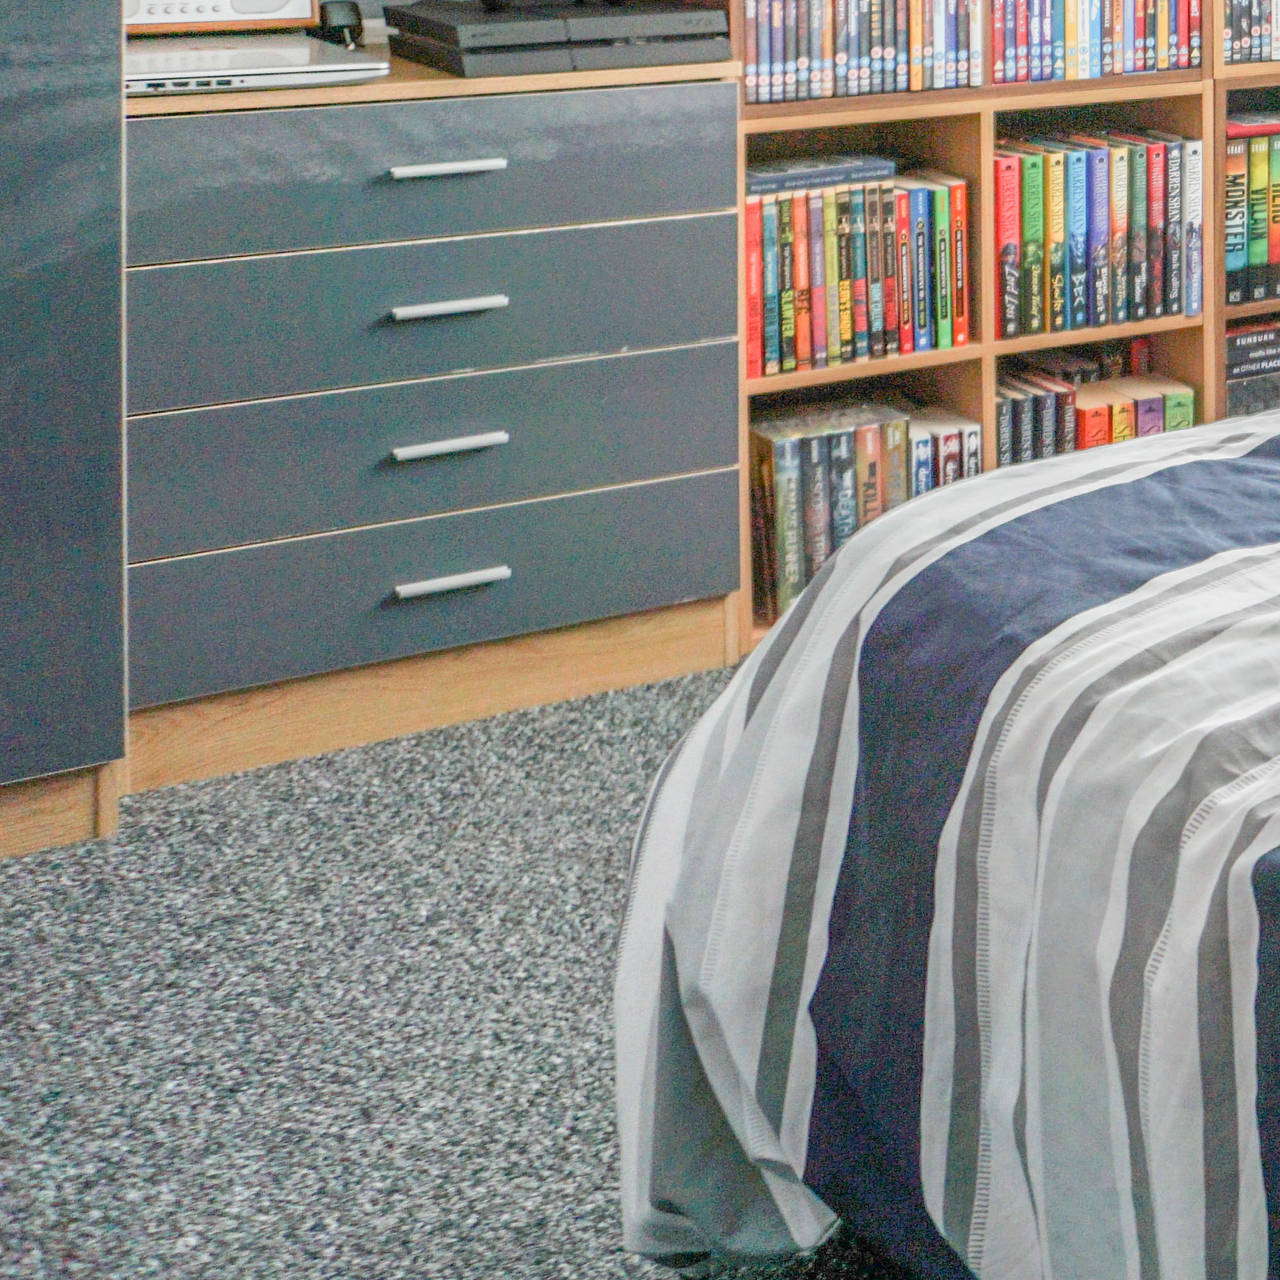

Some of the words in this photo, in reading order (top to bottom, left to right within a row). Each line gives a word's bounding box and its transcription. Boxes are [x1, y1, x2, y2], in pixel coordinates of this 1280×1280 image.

[1168, 160, 1180, 197] DARREN
[1188, 158, 1200, 197] DARREN
[1169, 198, 1180, 222] SHAN
[1188, 198, 1200, 222] SHAN
[1226, 174, 1245, 253] MONSTER
[1251, 188, 1267, 241] VILLAIN
[1171, 250, 1180, 270] Dark
[1004, 264, 1019, 294] Lord
[1170, 271, 1180, 299] Calling
[839, 280, 850, 310] DEATH'S
[1004, 294, 1018, 318] Loss
[781, 290, 794, 338] SLAWTER
[1236, 333, 1275, 346] SUNBURN
[1261, 359, 1280, 369] PLACE
[1000, 416, 1009, 451] DARREN
[839, 490, 854, 536] DEATH
[863, 482, 877, 517] KILL
